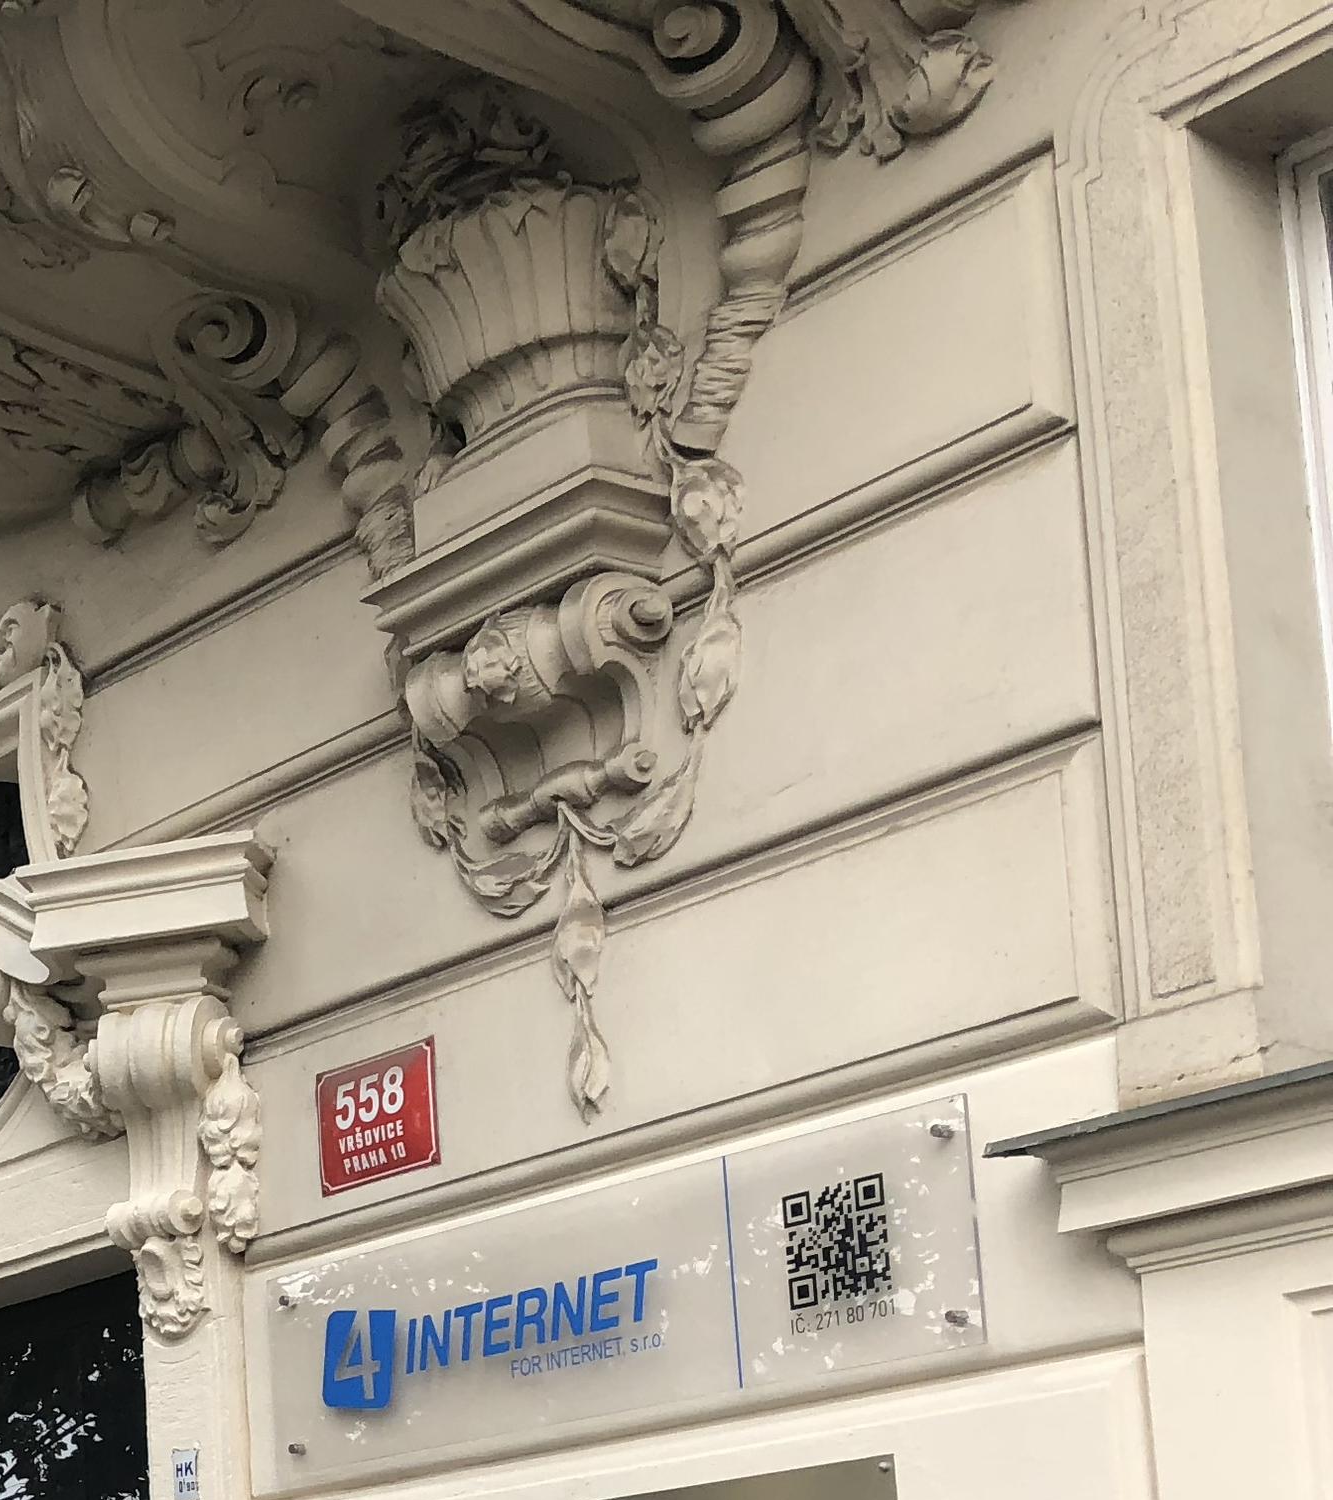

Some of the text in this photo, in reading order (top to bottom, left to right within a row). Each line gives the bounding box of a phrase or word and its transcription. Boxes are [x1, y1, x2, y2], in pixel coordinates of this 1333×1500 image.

[335, 1066, 404, 1130] 558
[339, 1120, 404, 1154] VRŠOVICE
[343, 1141, 407, 1175] PRAHA 10
[406, 1258, 658, 1375] INTERNET
[790, 1299, 895, 1335] IČ: 271 80 701
[510, 1354, 542, 1379] FOR
[175, 1461, 194, 1478] HK
